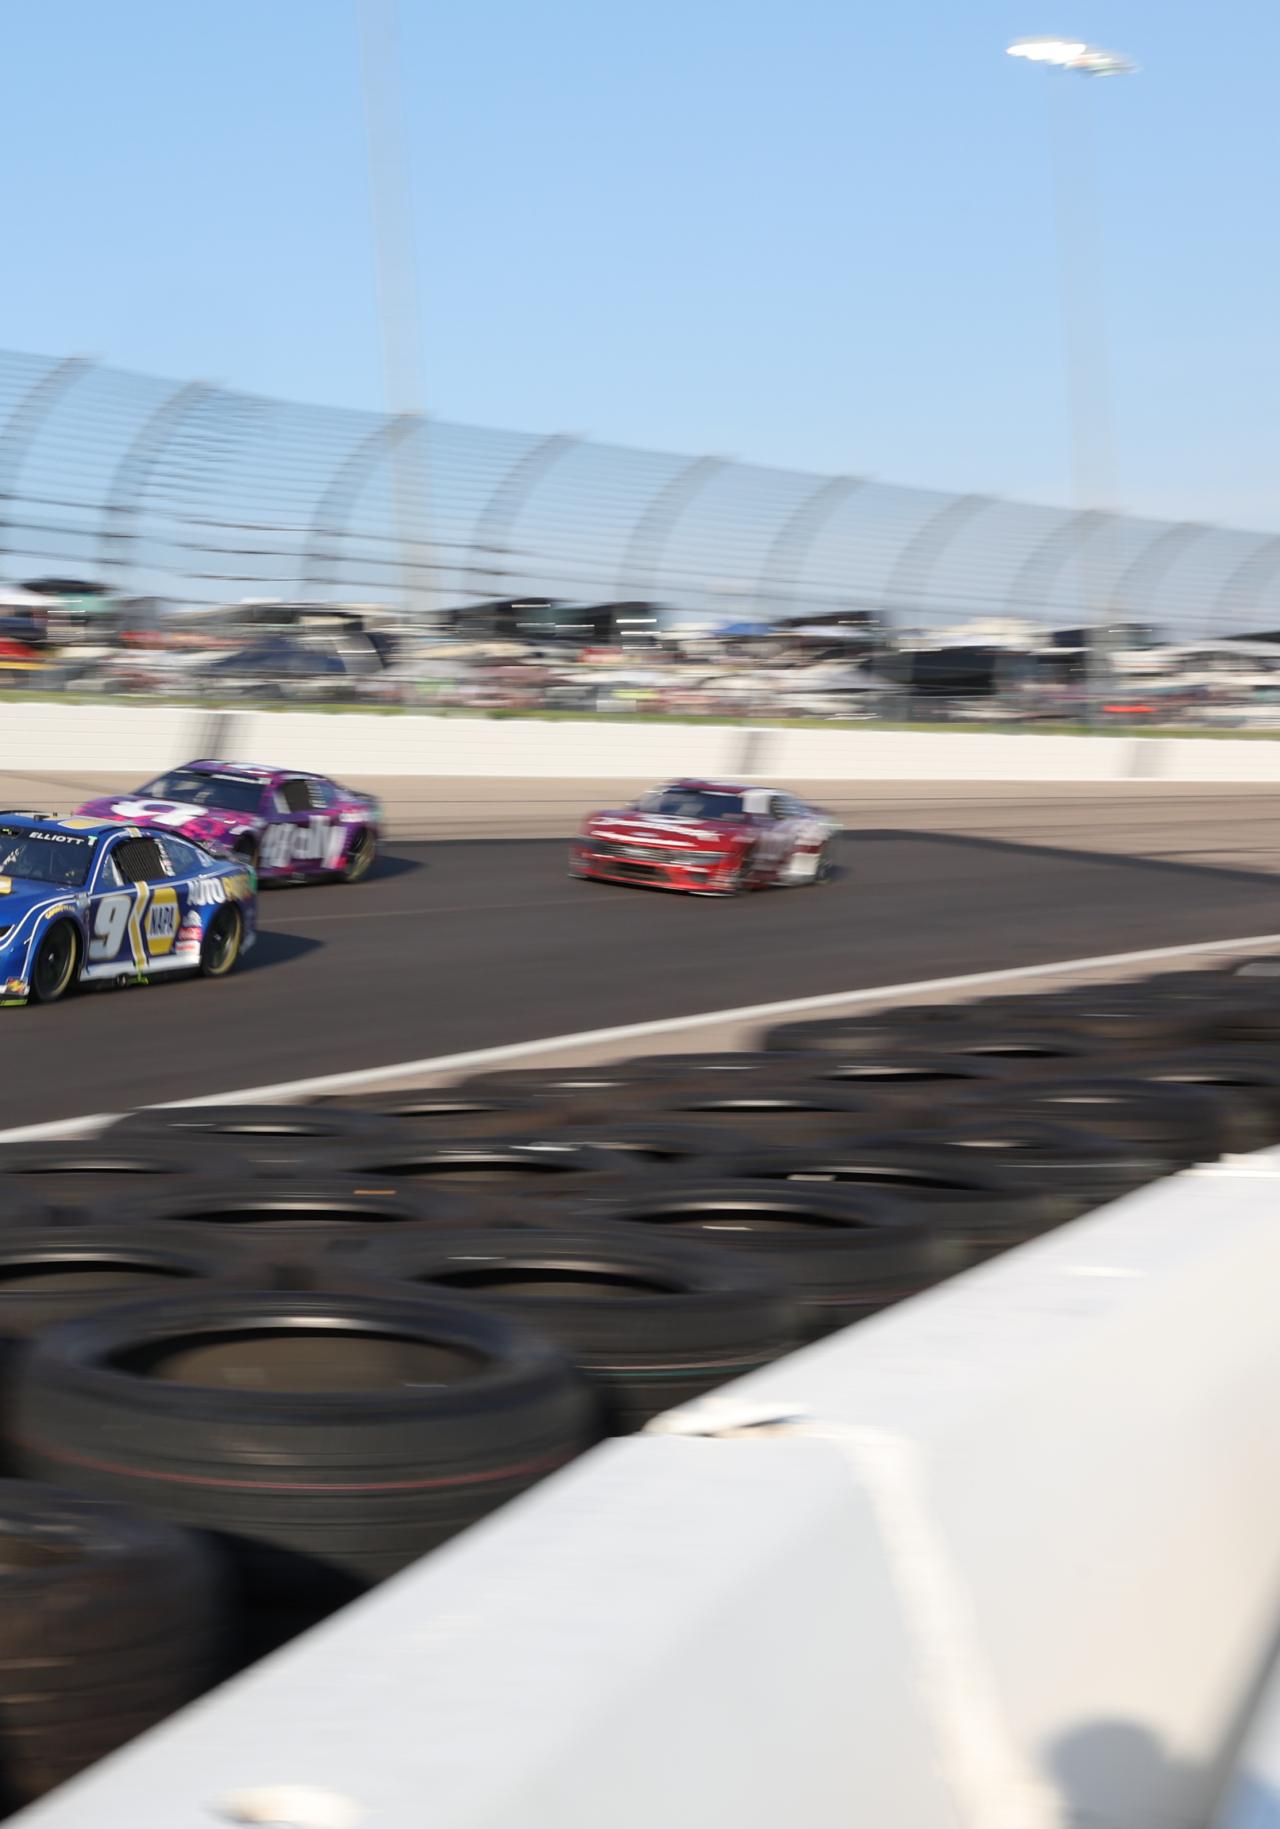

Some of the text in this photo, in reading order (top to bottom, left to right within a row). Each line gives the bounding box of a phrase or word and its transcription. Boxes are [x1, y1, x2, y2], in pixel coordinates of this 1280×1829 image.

[29, 831, 84, 845] ELLIOTT
[89, 894, 132, 960] 9
[150, 905, 177, 936] NAPA
